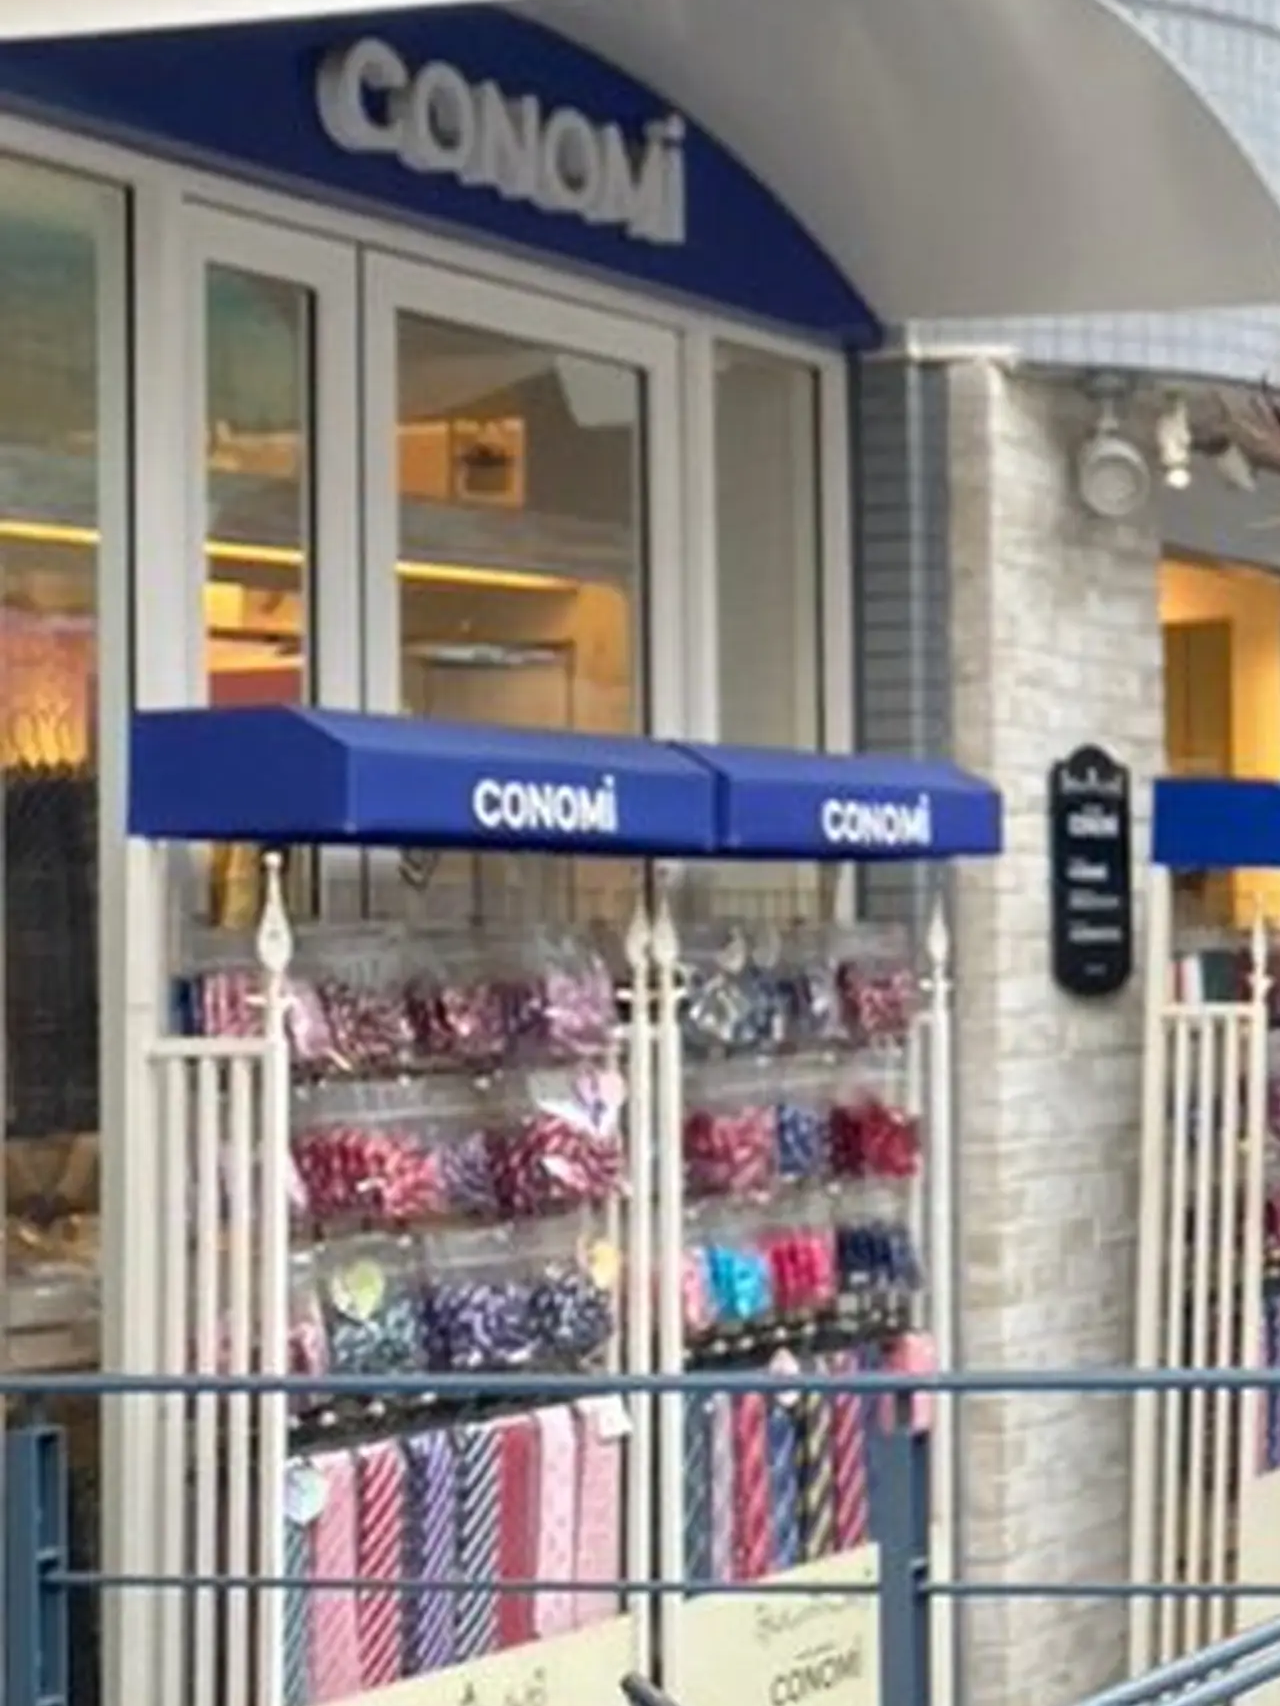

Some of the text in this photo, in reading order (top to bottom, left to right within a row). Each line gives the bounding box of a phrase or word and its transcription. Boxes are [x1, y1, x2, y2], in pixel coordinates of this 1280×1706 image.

[316, 37, 686, 245] CONOMi
[473, 773, 617, 833] CONOMi
[822, 793, 932, 846] CONOMi
